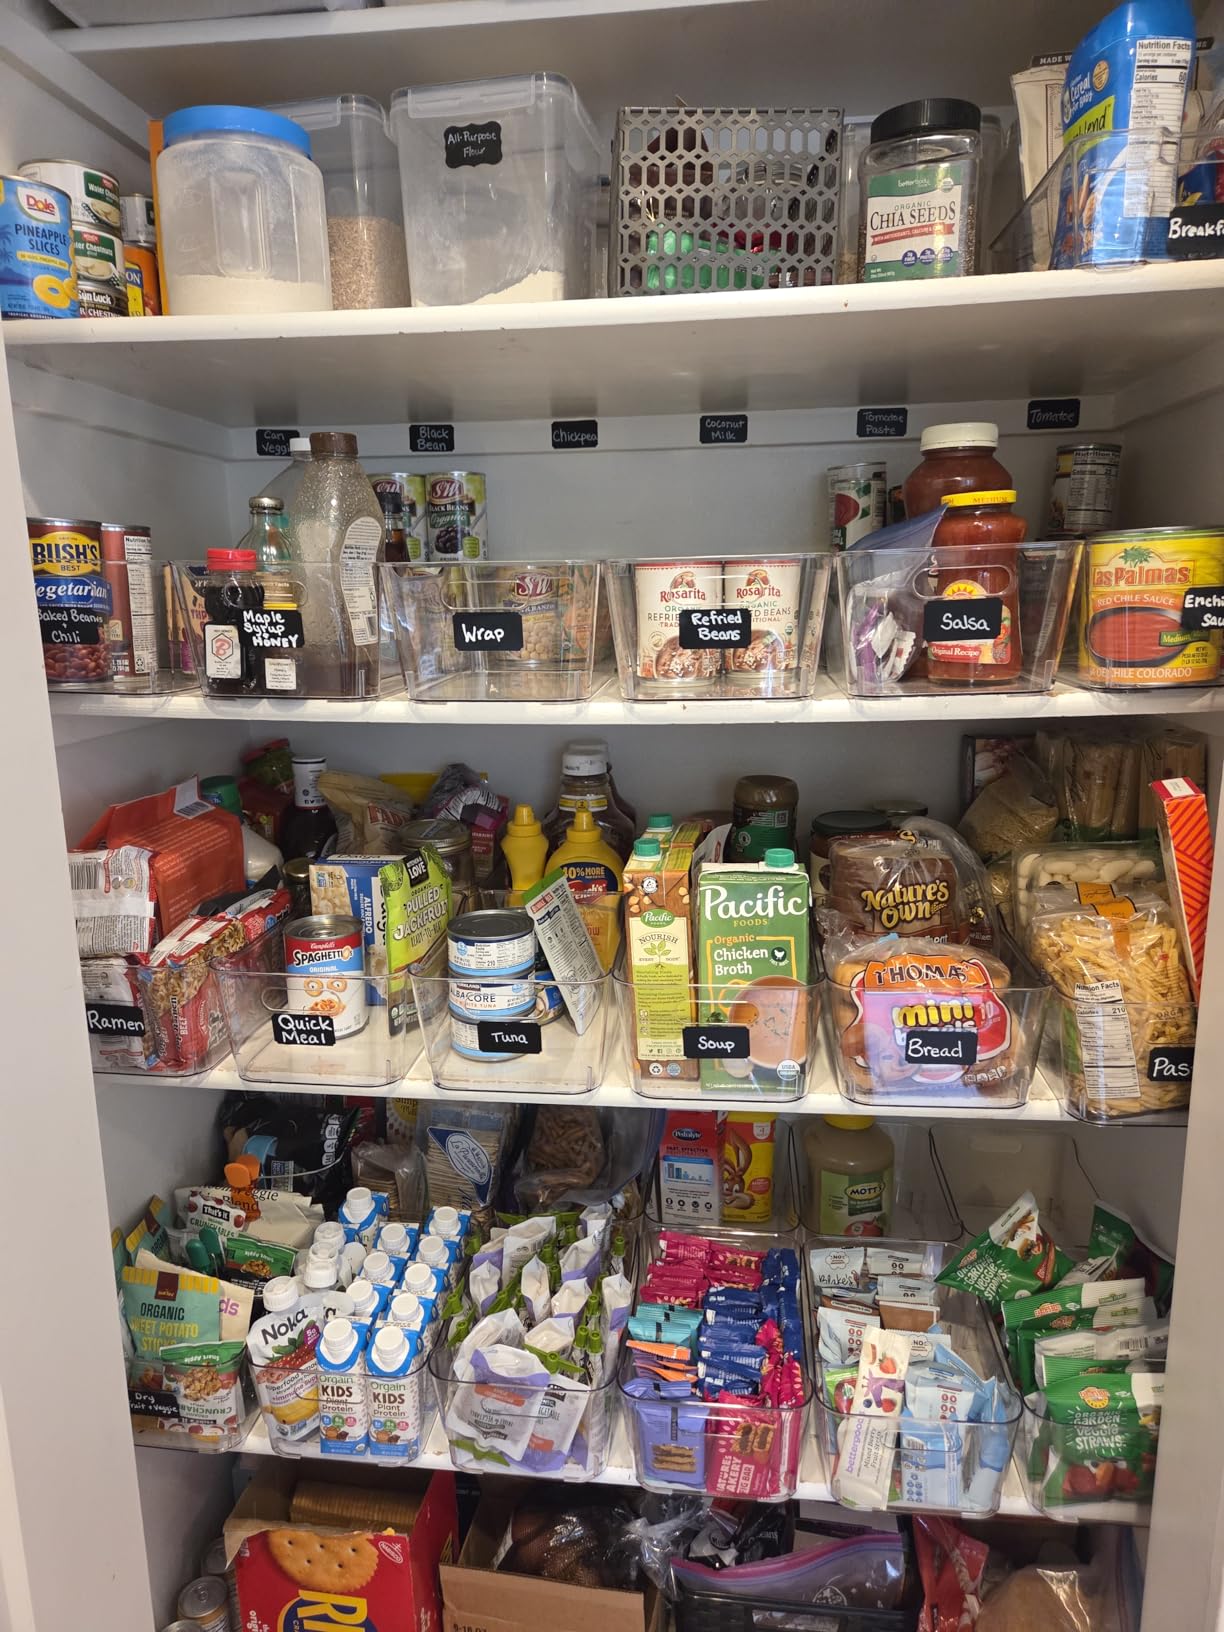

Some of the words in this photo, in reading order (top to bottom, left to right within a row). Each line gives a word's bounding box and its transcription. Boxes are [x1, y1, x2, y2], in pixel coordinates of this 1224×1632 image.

[1138, 41, 1170, 50] Nutrition
[1173, 41, 1191, 50] Facts
[1135, 73, 1158, 81] Calories
[447, 131, 497, 146] All-Purpose
[463, 147, 486, 158] Flour
[26, 194, 56, 212] Dole
[894, 200, 932, 211] ORGANIC
[870, 211, 906, 231] CHIA
[909, 201, 956, 225] SEEDS
[15, 223, 68, 246] PINEAPPLE
[1168, 217, 1224, 240] Breakf
[28, 239, 60, 256] SLICES
[93, 291, 112, 305] Luck
[705, 417, 745, 430] Coconut
[263, 430, 285, 440] Can
[419, 427, 449, 440] Black
[553, 428, 597, 446] Chickpea
[711, 430, 737, 441] Milk
[262, 441, 290, 456] Veggi
[417, 438, 447, 451] Bean
[31, 543, 98, 566] BUSH'S
[1114, 565, 1191, 586] Palmas
[34, 581, 108, 600] egetarian
[660, 589, 706, 602] Rosarita
[736, 585, 781, 599] Rosarita
[1113, 594, 1139, 604] CHILE
[1143, 594, 1175, 606] SAUCE
[1184, 594, 1224, 608] Enchi
[71, 609, 103, 623] Beans
[243, 610, 285, 626] Maple
[648, 613, 680, 621] REFRIE
[691, 610, 742, 626] Refried
[763, 607, 791, 616] BEANS
[940, 613, 990, 631] Salsa
[1201, 613, 1224, 628] Sau
[244, 622, 285, 637] Syrup
[461, 623, 505, 643] Wrap
[698, 627, 741, 641] Beans
[51, 631, 81, 643] Chili
[252, 634, 298, 648] HONEY
[954, 646, 980, 657] Recipe
[1136, 667, 1192, 678] COLORADO
[408, 861, 427, 879] LOVE
[585, 867, 605, 876] MORE
[406, 887, 441, 917] PULLED
[861, 880, 950, 911] Nature's
[700, 885, 808, 921] Pacific
[364, 897, 373, 934] ALFREDO
[644, 911, 672, 923] Pacific
[881, 901, 931, 928] Own
[733, 918, 768, 928] FOODS
[638, 933, 679, 945] NOURISH
[714, 933, 755, 947] Organic
[714, 946, 769, 962] Chicken
[715, 961, 752, 977] Broth
[1101, 981, 1120, 989] Facts
[892, 996, 974, 1027] mini
[1112, 1007, 1126, 1015] 210
[86, 1009, 144, 1032] Ramen
[277, 1015, 333, 1031] Quick
[281, 1031, 326, 1045] Meal
[491, 1032, 528, 1044] Tuna
[698, 1036, 735, 1053] Soup
[908, 1039, 963, 1058] Bread
[1153, 1057, 1190, 1078] Pas
[984, 1269, 1007, 1300] STRAWS
[140, 1302, 185, 1321] ORGANIC
[160, 1320, 199, 1338] POTATO
[261, 1308, 309, 1345] Noka
[320, 1375, 354, 1385] Orgain
[370, 1381, 406, 1393] Orgain
[135, 1392, 155, 1404] Dry
[321, 1385, 353, 1398] KIDS
[372, 1392, 405, 1405] KIDS
[130, 1402, 146, 1410] ruit
[154, 1404, 178, 1415] Veggie
[180, 1405, 233, 1414] CRUNCHAB
[322, 1404, 353, 1413] Protein
[374, 1409, 406, 1417] Protein
[377, 1404, 400, 1412] Plant
[1075, 1435, 1122, 1450] STRAWS
[864, 1447, 873, 1468] Mixed
[871, 1450, 879, 1468] Fruit
[726, 1456, 742, 1493] AKERY
[742, 1466, 753, 1481] BAR
[297, 1589, 367, 1632] RI
